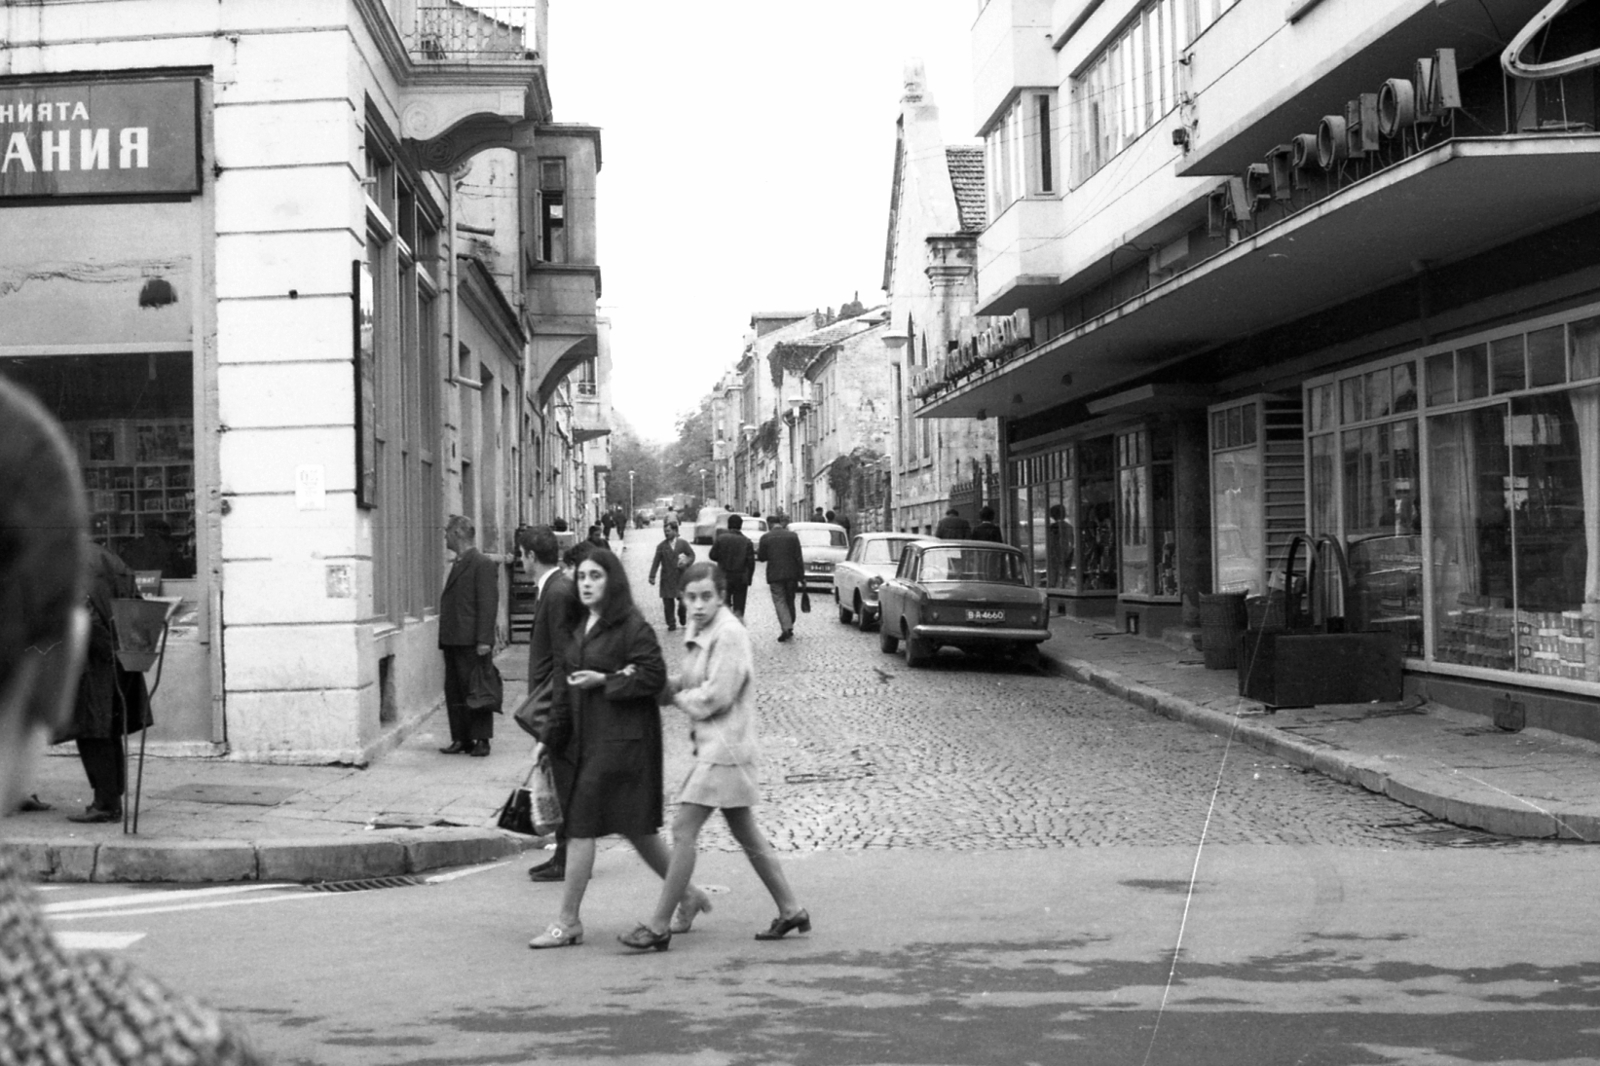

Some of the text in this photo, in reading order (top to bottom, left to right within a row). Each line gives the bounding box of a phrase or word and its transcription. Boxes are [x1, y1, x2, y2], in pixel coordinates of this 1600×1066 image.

[0, 101, 90, 123] НИЯТА
[1, 127, 149, 173] АНИЯ
[1206, 48, 1462, 238] ГАСТРОНОМ
